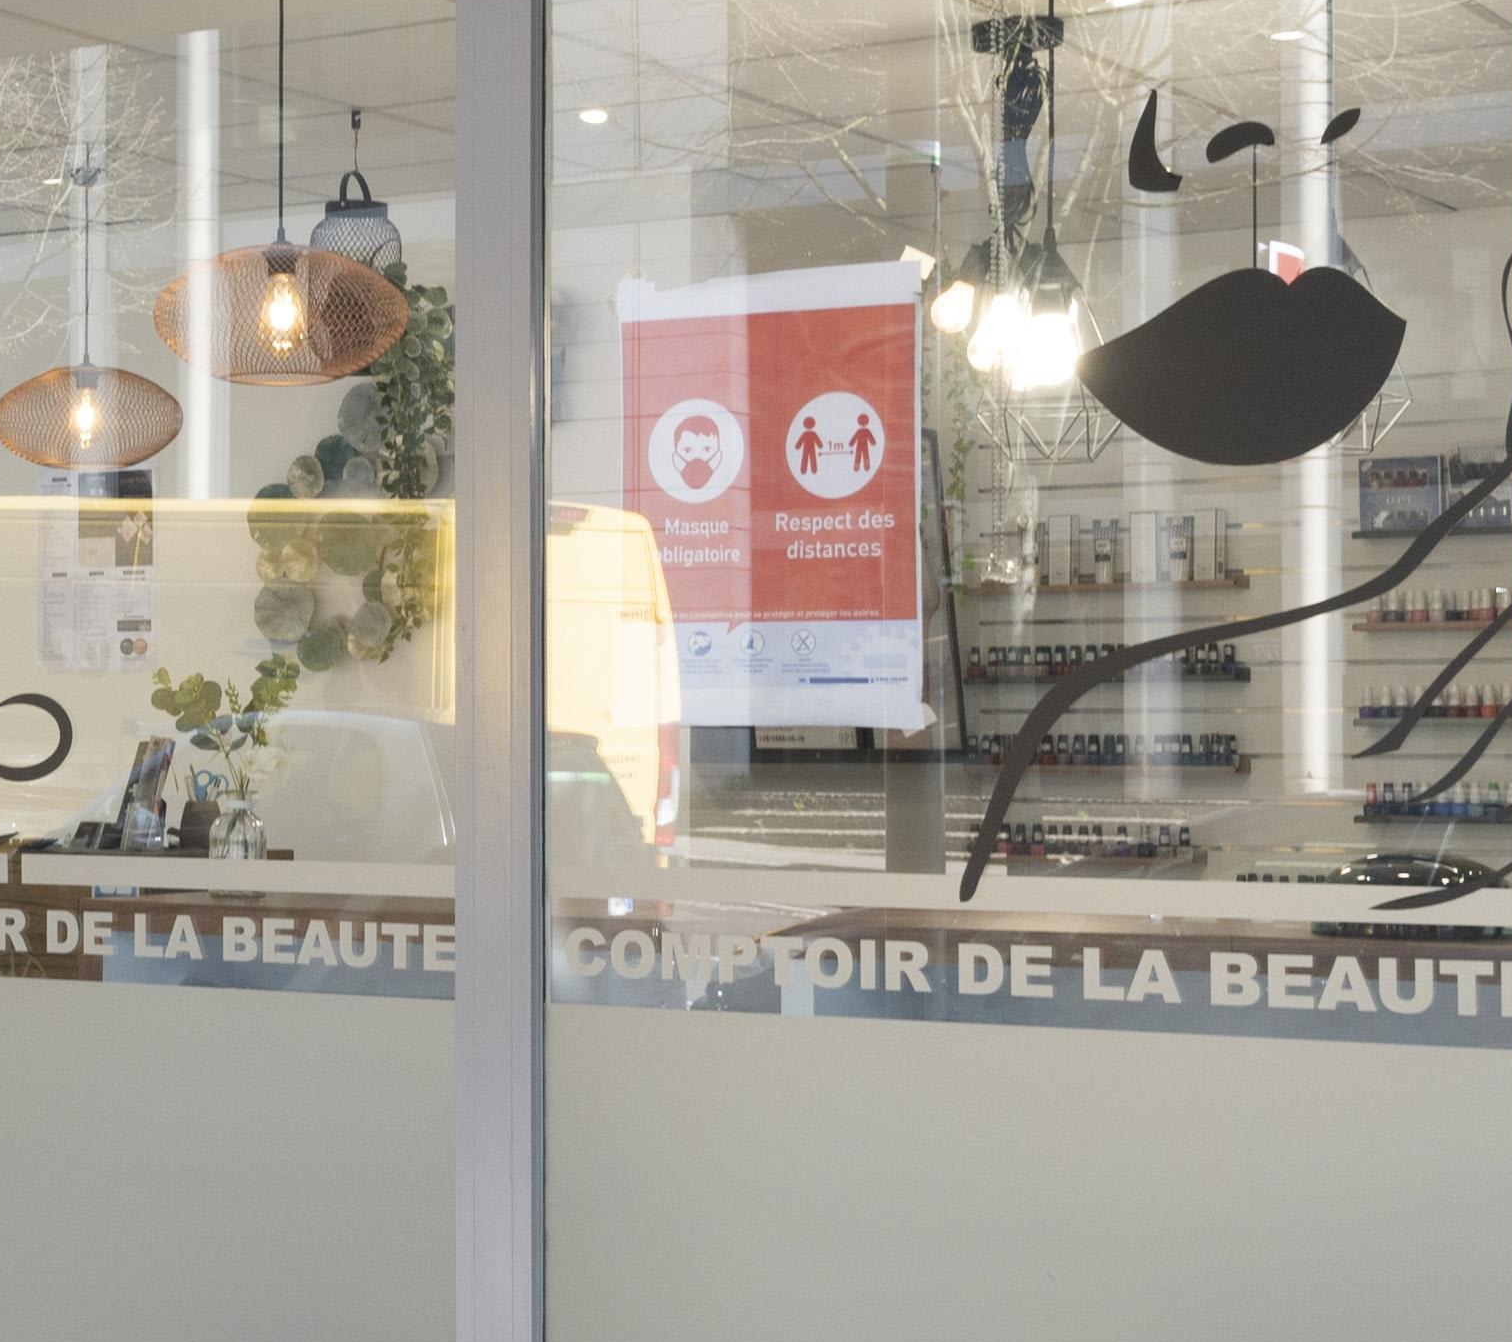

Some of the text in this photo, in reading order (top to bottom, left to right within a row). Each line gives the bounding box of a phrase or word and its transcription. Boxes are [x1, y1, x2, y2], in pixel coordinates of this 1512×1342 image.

[827, 440, 844, 452] 1m
[664, 517, 729, 538] Masque
[775, 509, 895, 535] Respect des
[655, 546, 740, 567] obligatoire
[787, 540, 882, 560] distances
[46, 910, 113, 955] DE
[134, 913, 204, 960] LA
[221, 916, 456, 973] BEAUTE
[564, 927, 932, 994] COMPTOIR
[957, 941, 1056, 998] DE
[1083, 946, 1182, 1006] LA
